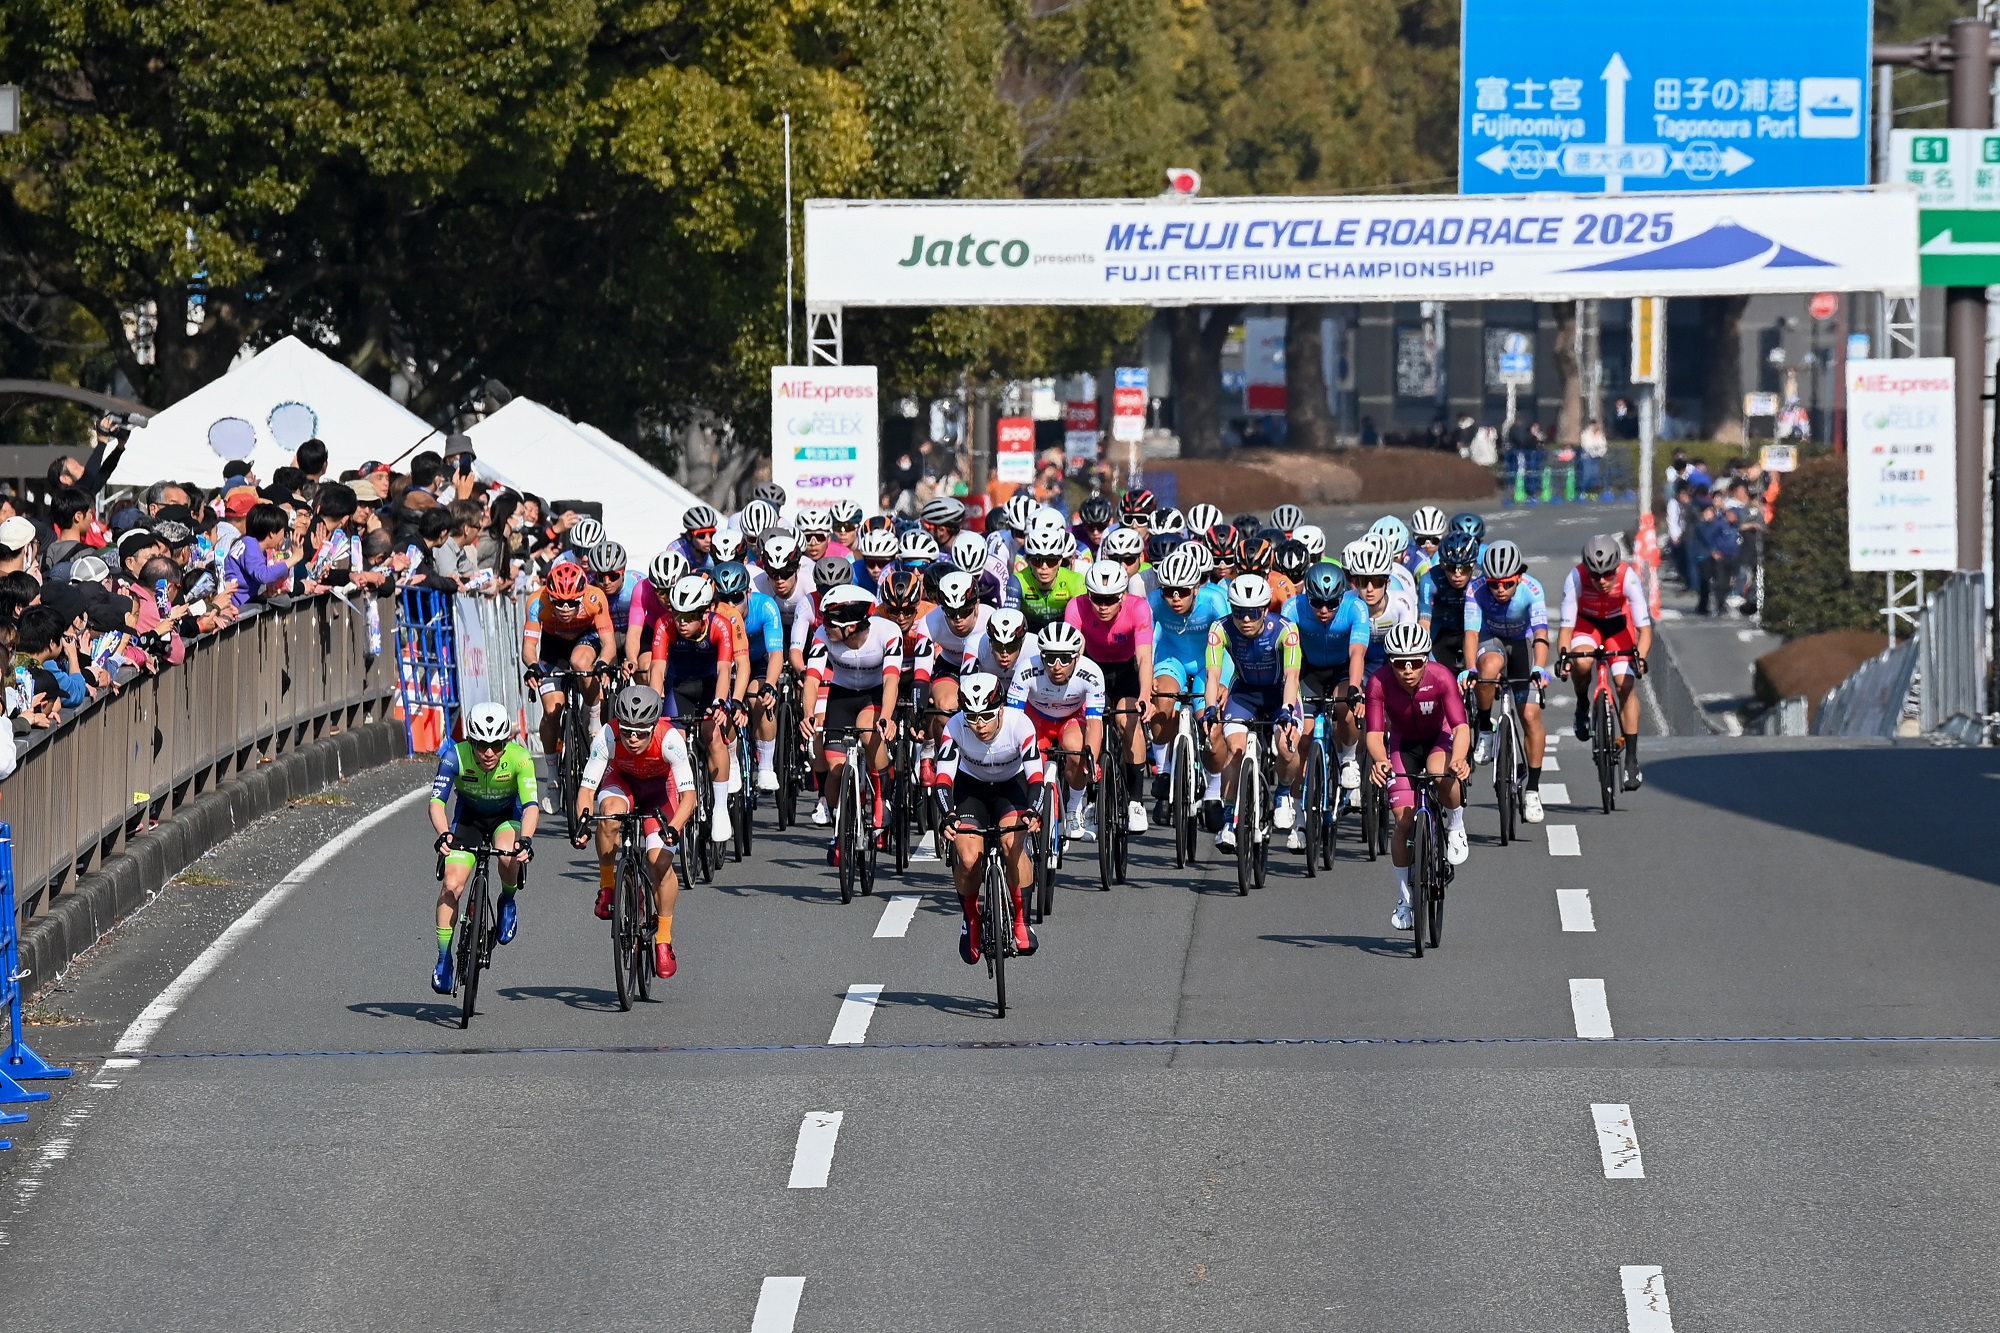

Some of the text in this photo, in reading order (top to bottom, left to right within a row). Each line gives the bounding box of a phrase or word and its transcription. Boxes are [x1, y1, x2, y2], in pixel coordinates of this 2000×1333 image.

[1475, 76, 1584, 111] 富士宮
[1654, 77, 1798, 112] 田子の浦港
[1471, 112, 1586, 141] Fujinomiya
[1652, 114, 1797, 141] Tagonoura Port
[1915, 139, 1944, 161] E1
[1985, 139, 2000, 161] E
[1906, 168, 1953, 188] 東名
[1105, 222, 1239, 251] Mt.FUJI
[1244, 220, 1361, 248] CYCLE
[1573, 212, 1675, 245] 2025
[897, 233, 1096, 268] Jatco presents
[1104, 260, 1495, 281] FUJI CRITERIUM CHAMPIONSHIP
[777, 381, 874, 402] AliExpress
[1853, 375, 1952, 395] AliExpress
